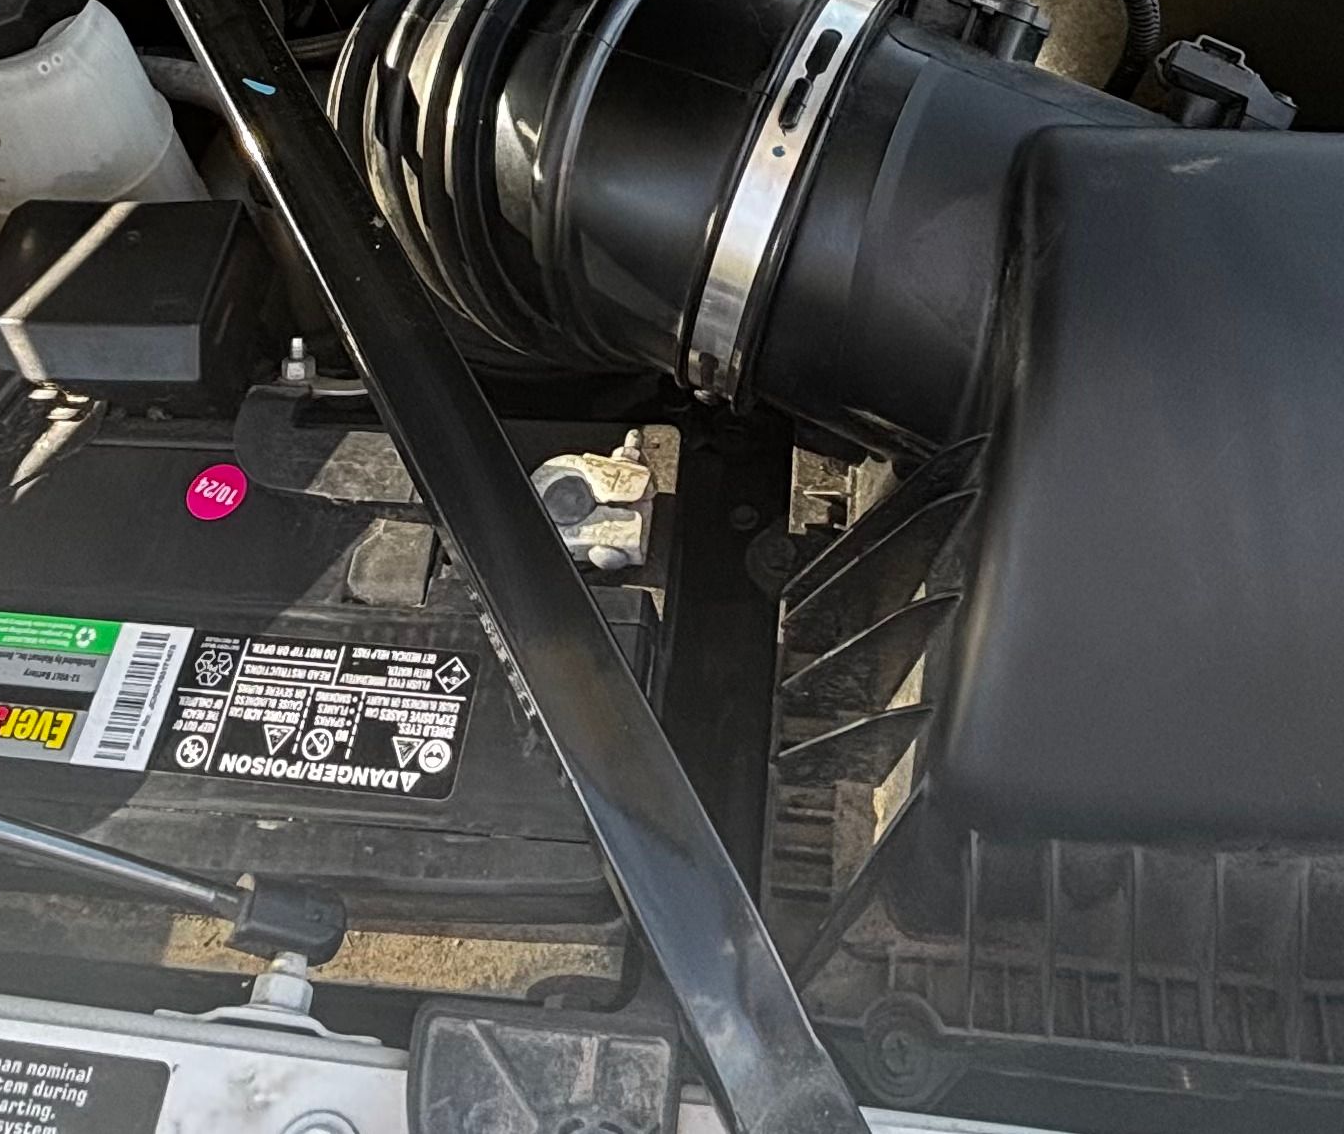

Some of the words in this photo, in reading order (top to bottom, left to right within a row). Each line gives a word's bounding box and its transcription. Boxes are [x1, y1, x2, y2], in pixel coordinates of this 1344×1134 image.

[193, 475, 238, 505] 10/24
[217, 752, 398, 788] DANGER/POISON
[26, 1063, 94, 1084] nominal
[32, 1080, 88, 1108] during
